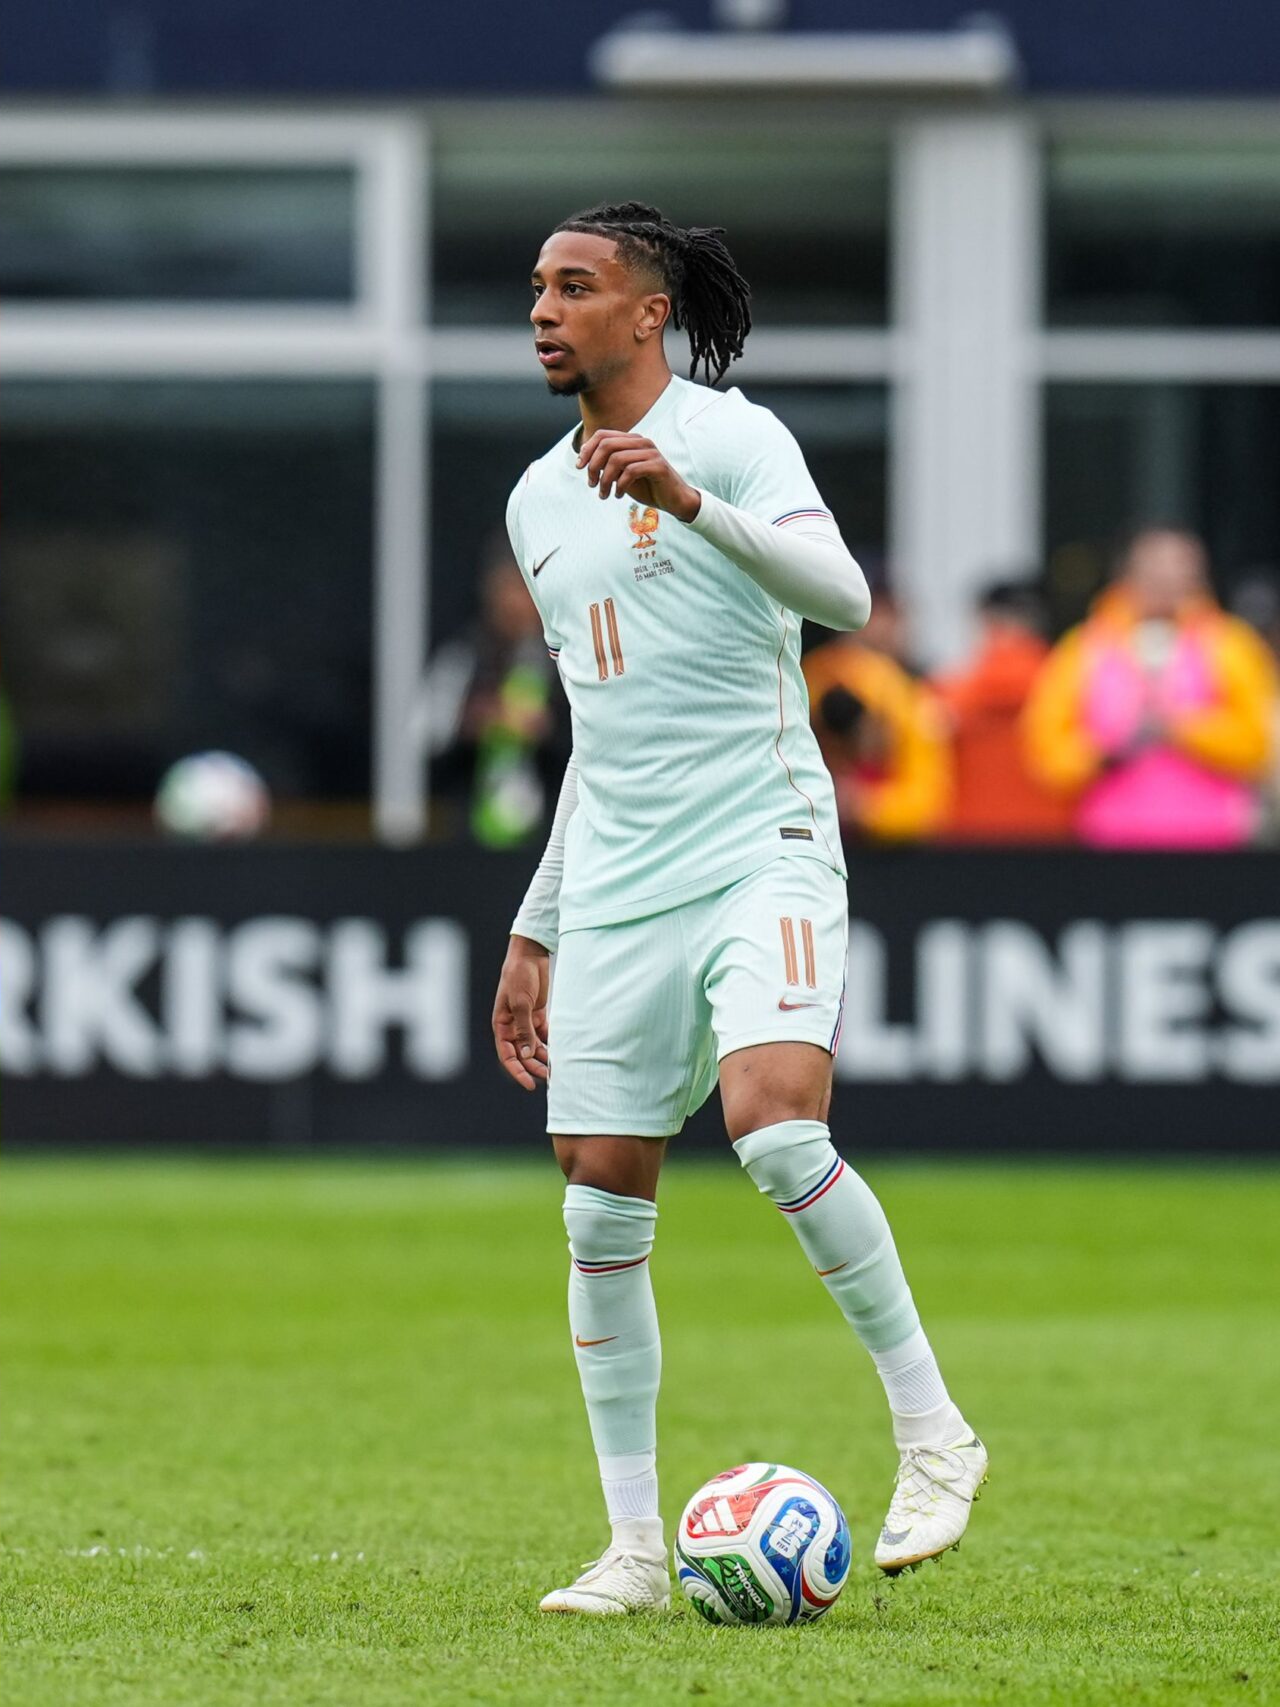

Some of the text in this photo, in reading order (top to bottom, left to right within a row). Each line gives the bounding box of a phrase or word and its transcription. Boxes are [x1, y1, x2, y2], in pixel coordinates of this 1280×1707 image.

[643, 569, 658, 579] MARS
[652, 559, 672, 569] FRANCE
[589, 597, 625, 681] 11
[779, 916, 817, 989] 11
[734, 1561, 766, 1609] TRIONDA
